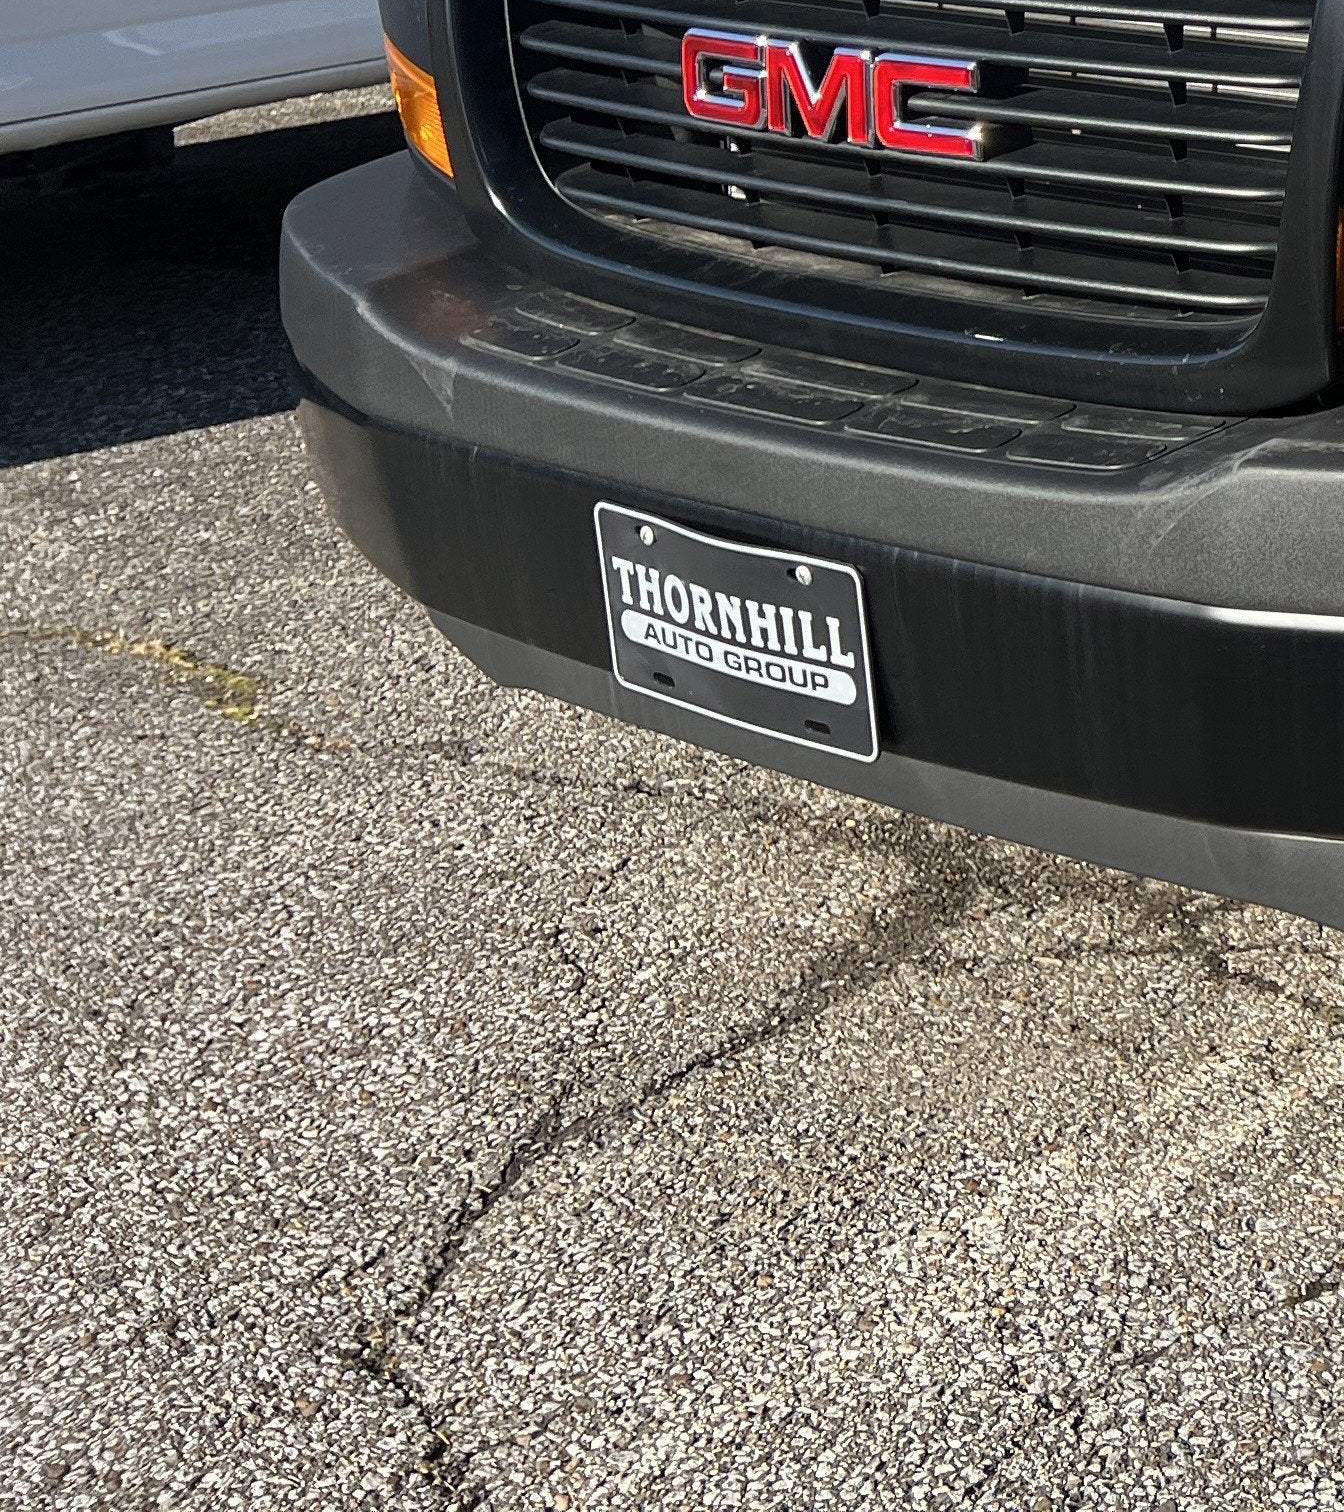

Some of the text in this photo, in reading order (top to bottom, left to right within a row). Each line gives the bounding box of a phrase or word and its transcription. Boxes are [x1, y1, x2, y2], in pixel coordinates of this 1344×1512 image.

[681, 27, 985, 162] GMC
[611, 556, 856, 669] THORNHILL
[643, 622, 830, 692] AUTO GROUP
